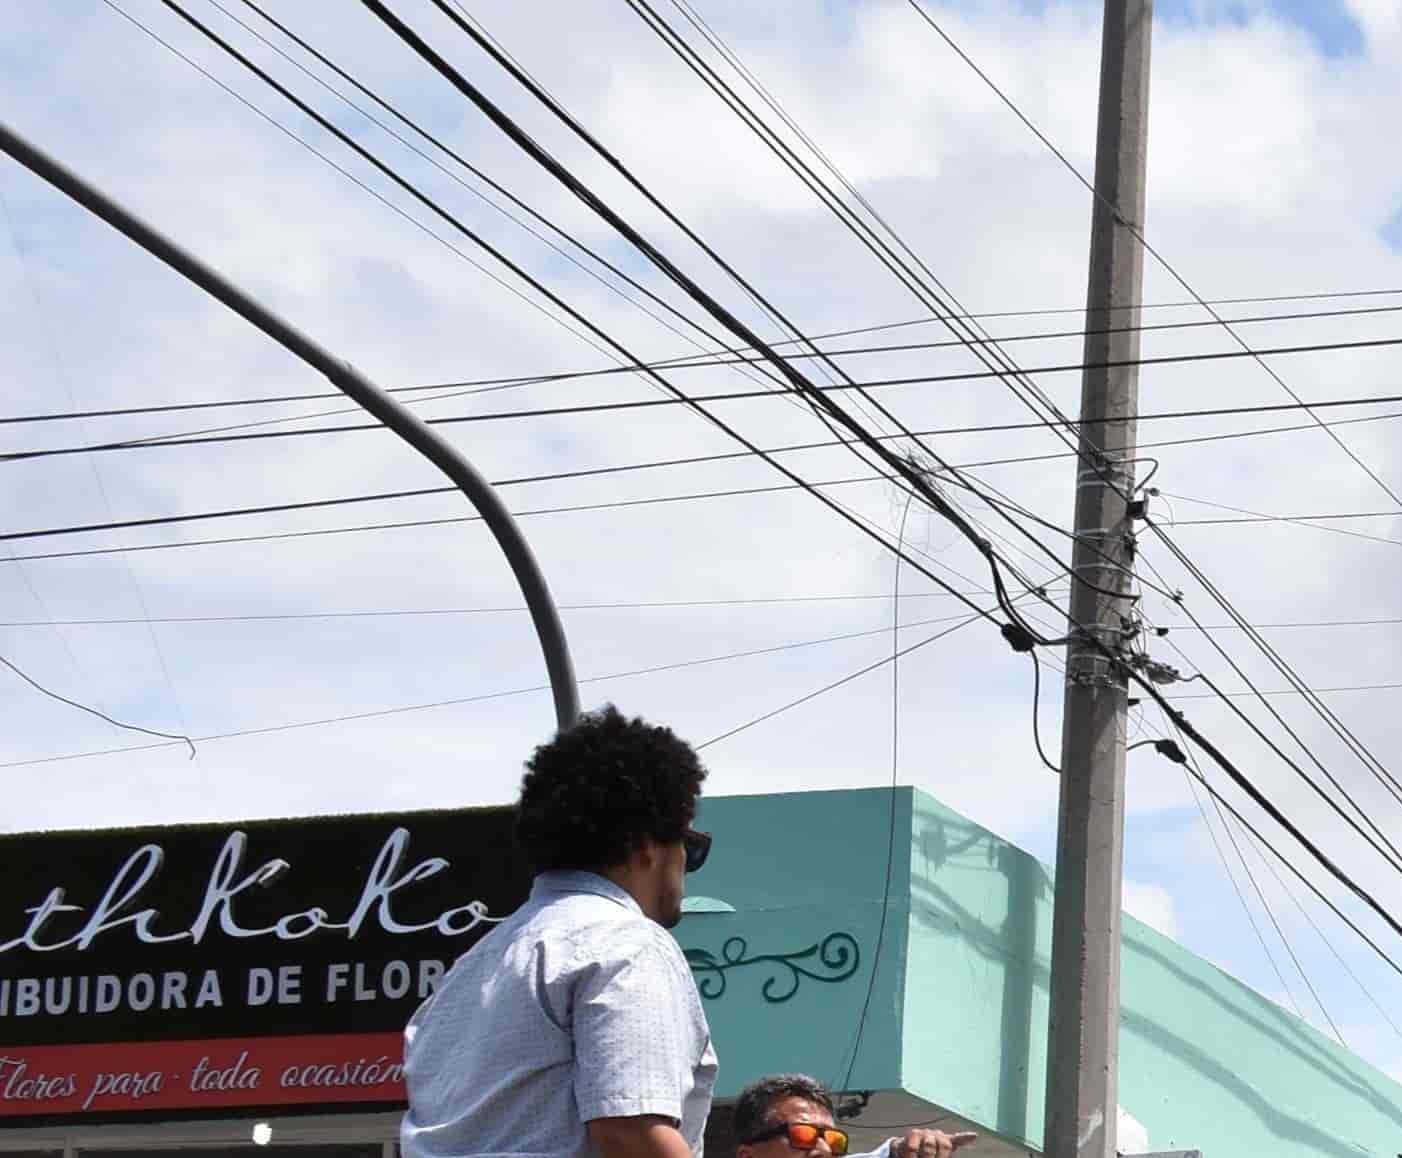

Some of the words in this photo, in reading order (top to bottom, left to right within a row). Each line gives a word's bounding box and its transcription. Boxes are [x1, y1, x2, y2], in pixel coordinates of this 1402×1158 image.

[247, 965, 302, 1006] DE
[81, 1071, 163, 1112] para
[190, 1051, 261, 1092] toda
[281, 1055, 404, 1088] ocasión
